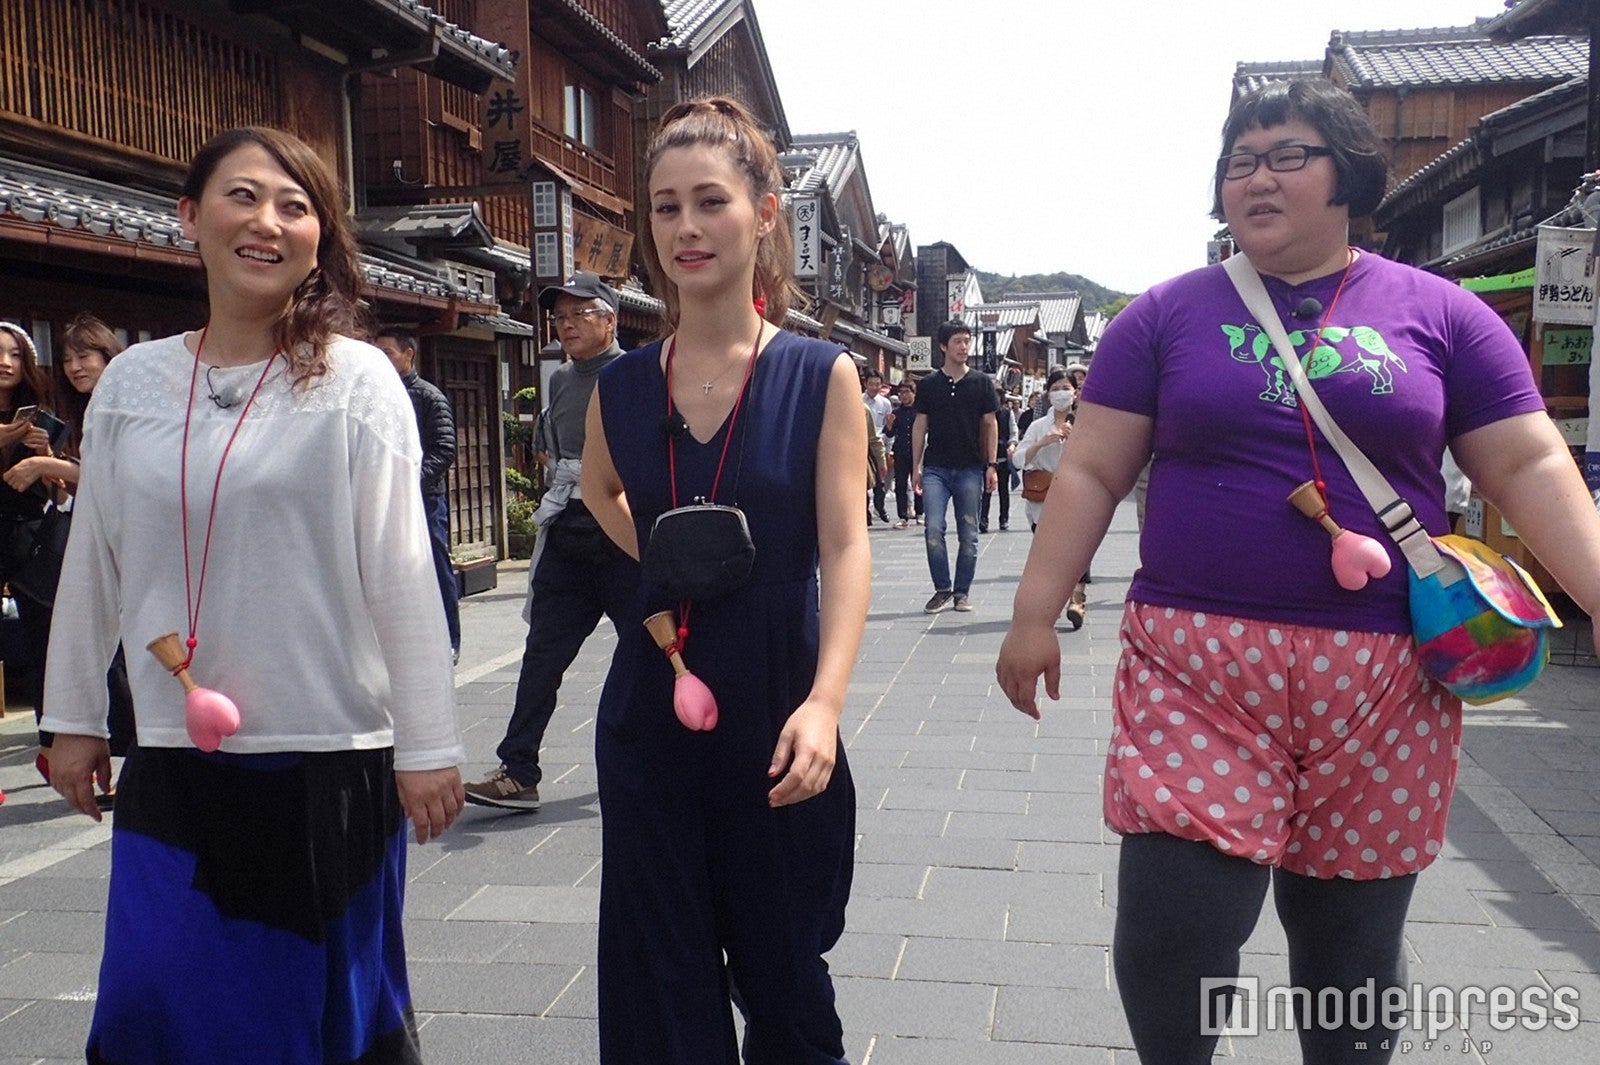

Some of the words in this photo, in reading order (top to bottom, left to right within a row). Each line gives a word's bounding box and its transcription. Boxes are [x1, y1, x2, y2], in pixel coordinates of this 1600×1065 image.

[1539, 283, 1593, 303] 伊勢うどん
